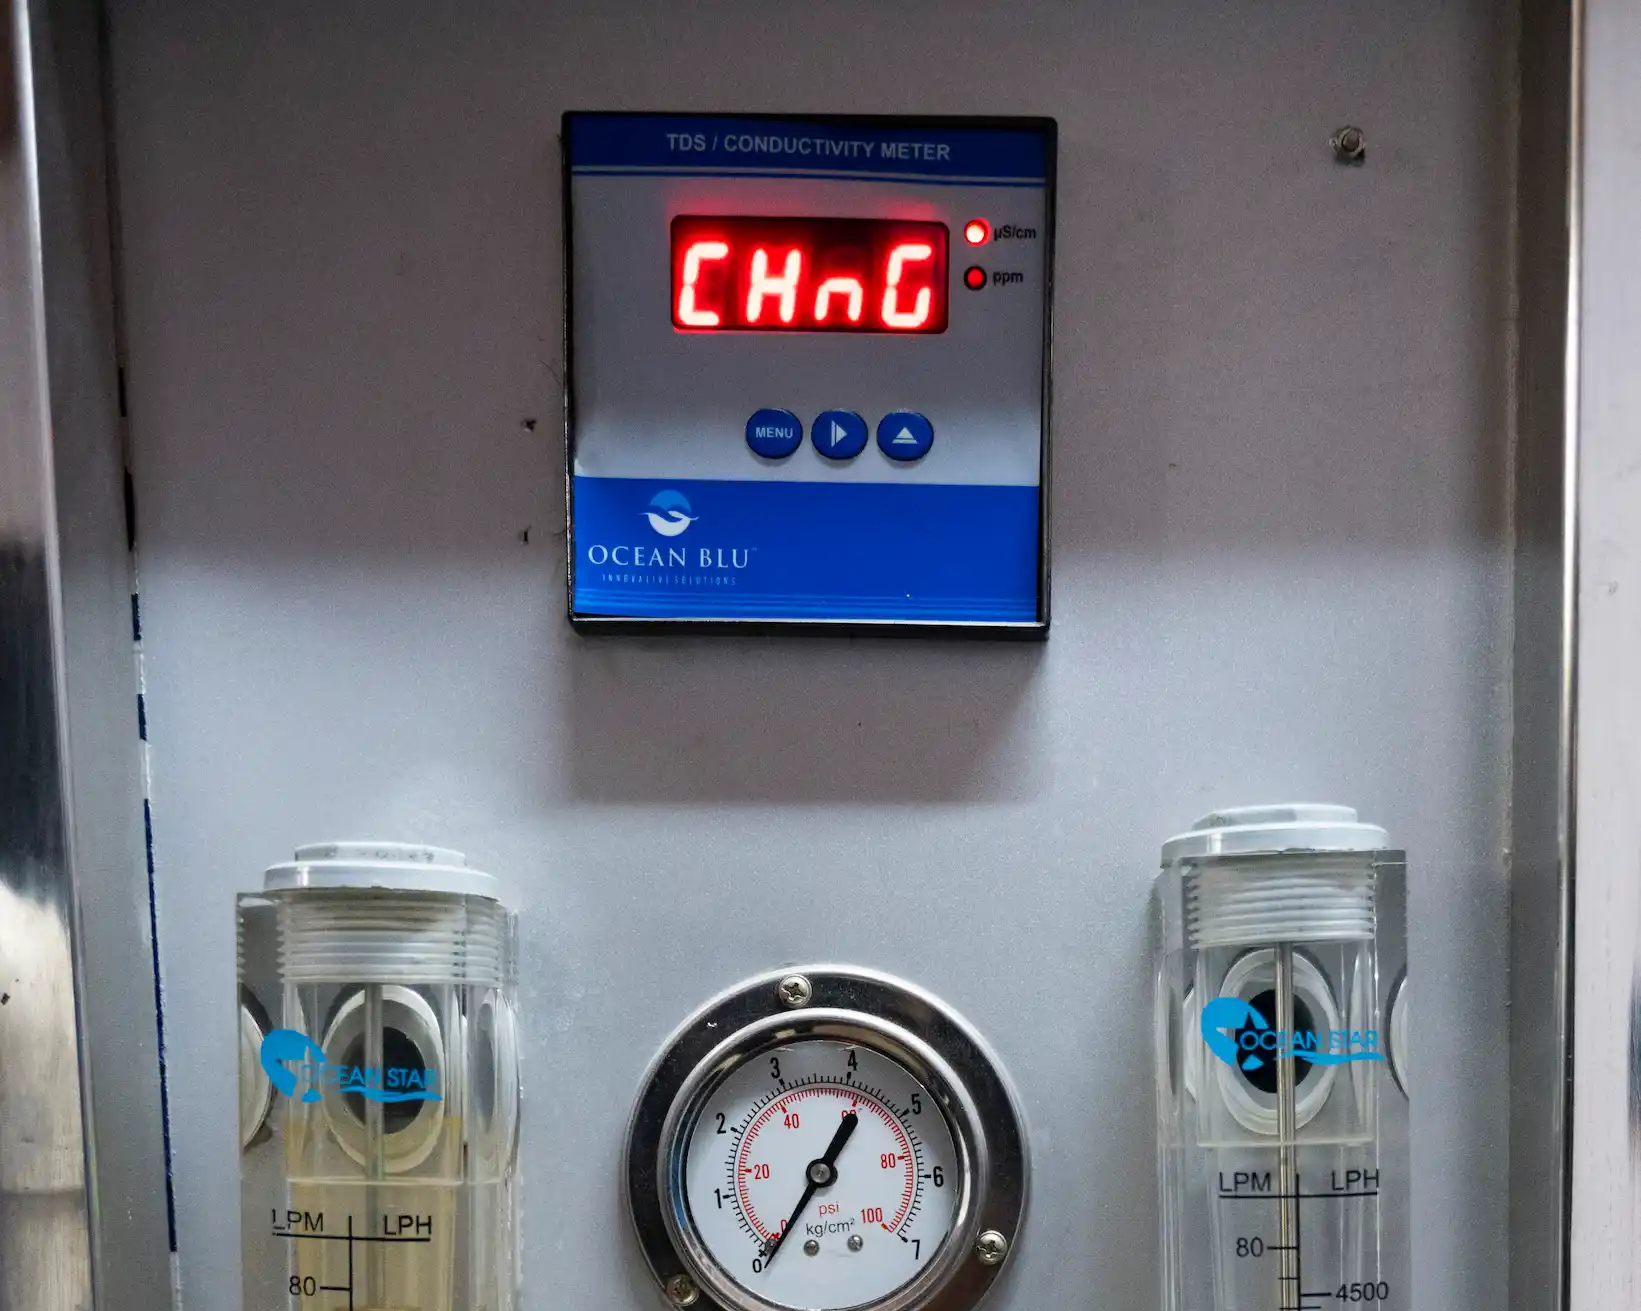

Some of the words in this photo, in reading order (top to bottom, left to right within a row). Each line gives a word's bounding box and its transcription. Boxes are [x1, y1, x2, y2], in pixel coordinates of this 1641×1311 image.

[666, 133, 706, 151] TDS
[723, 134, 875, 158] CONDUCTIVITY
[880, 143, 950, 161] METER
[993, 272, 1023, 286] ppm
[755, 427, 793, 440] MENU
[588, 545, 686, 567] OCEAN
[699, 548, 749, 568] BLU
[1240, 1030, 1321, 1050] OCEAN
[1328, 1030, 1379, 1049] STAR
[770, 1057, 781, 1079] 3
[847, 1050, 858, 1072] 4
[387, 1067, 437, 1088] STAR
[911, 1093, 922, 1115] 5
[715, 1112, 726, 1135] 2
[784, 1113, 800, 1129] 40
[880, 1152, 896, 1169] 80
[754, 1164, 770, 1180] 20
[933, 1165, 944, 1188] 6
[1219, 1172, 1271, 1192] LPM
[1331, 1168, 1379, 1190] LPH
[714, 1187, 722, 1209] 1
[819, 1201, 840, 1217] psi
[860, 1207, 883, 1224] 100
[384, 1214, 432, 1235] LPH
[911, 1240, 921, 1260] 7
[1236, 1237, 1264, 1257] 80
[752, 1258, 762, 1274] 0
[289, 1276, 316, 1296] 80
[1335, 1282, 1389, 1302] 4500
